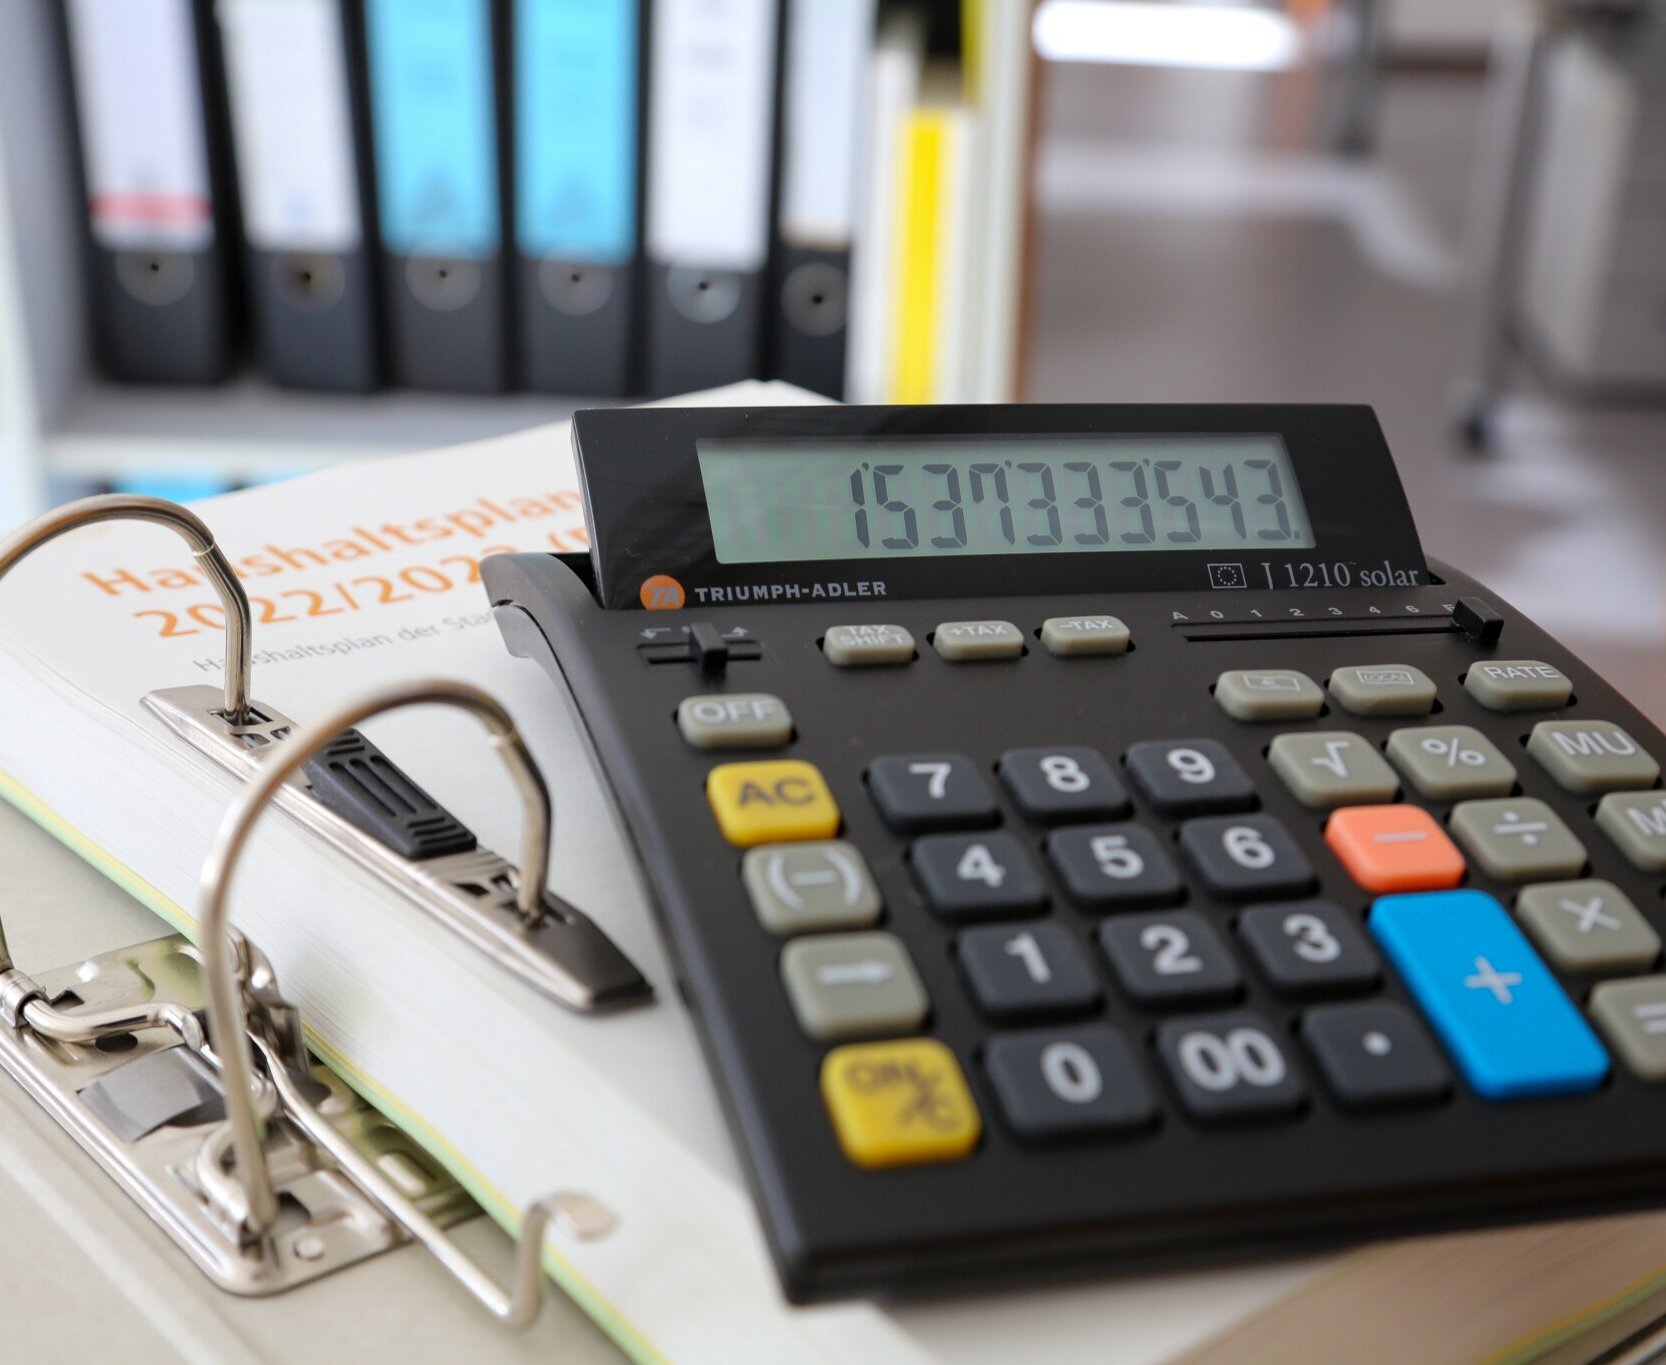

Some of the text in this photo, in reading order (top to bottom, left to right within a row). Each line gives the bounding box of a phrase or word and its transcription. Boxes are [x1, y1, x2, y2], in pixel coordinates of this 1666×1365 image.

[82, 490, 585, 596] Hashaltsplan
[133, 545, 520, 638] 2022/202
[694, 581, 887, 603] TRIUMPH-ADLER
[1261, 560, 1419, 591] J 1210 solar
[848, 624, 889, 636] TAX
[1172, 611, 1188, 621] A
[1210, 610, 1224, 619] 0
[1250, 608, 1263, 618] 1
[1289, 607, 1305, 617] 2
[1328, 606, 1343, 616] 3
[1368, 605, 1381, 615] 4
[1405, 604, 1419, 614] 6
[192, 627, 393, 672] Hshaltsplan
[397, 620, 442, 643] der
[839, 633, 905, 647] SHIFT
[1484, 666, 1561, 679] RATE
[692, 701, 775, 724] OFF
[1421, 736, 1487, 768] %
[1551, 731, 1637, 756] MU
[908, 761, 952, 798] 7
[1040, 756, 1090, 793] 8
[1167, 748, 1217, 784] 9
[737, 776, 815, 808] AC
[957, 844, 1006, 887] 4
[1090, 835, 1144, 879] 5
[1222, 825, 1276, 869] 6
[1140, 924, 1202, 975] 2
[1282, 913, 1342, 963] 3
[1005, 932, 1052, 984] 1
[1040, 1042, 1102, 1103] 0
[1178, 1027, 1286, 1091] 00
